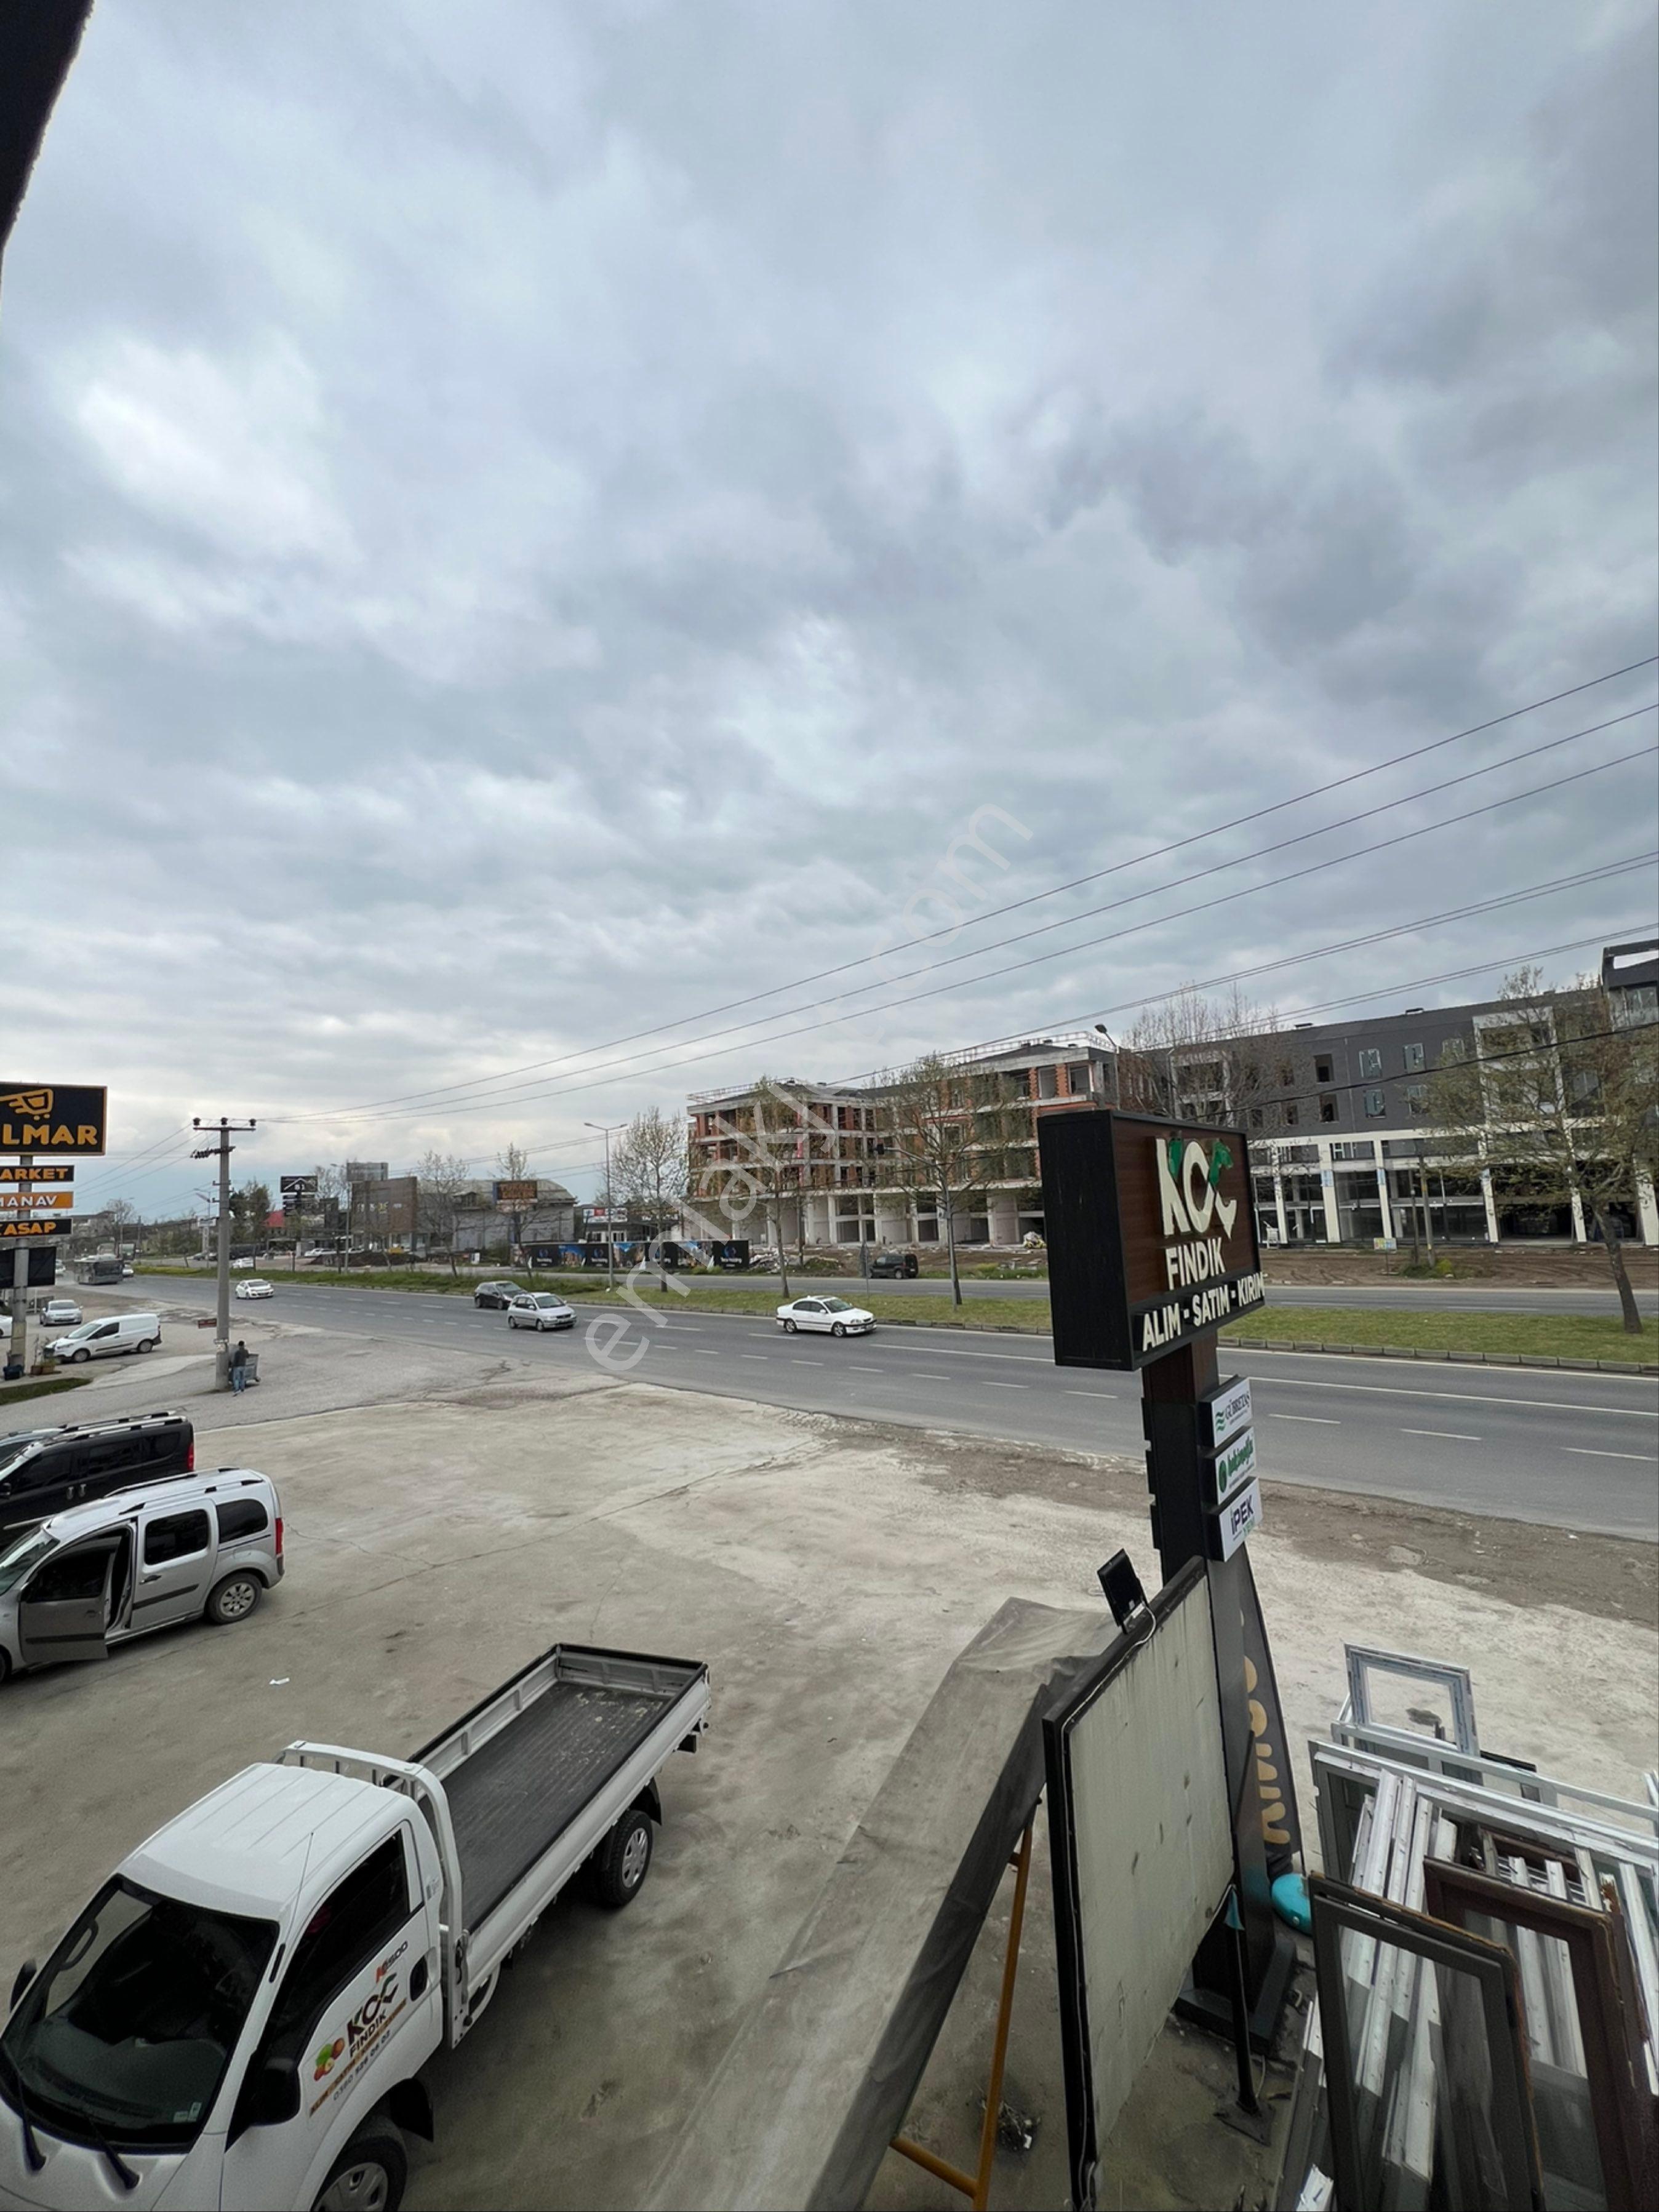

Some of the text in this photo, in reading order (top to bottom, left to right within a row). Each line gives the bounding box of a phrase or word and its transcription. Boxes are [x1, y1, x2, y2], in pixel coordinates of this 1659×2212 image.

[0, 1221, 57, 1236] ASAP
[1165, 1237, 1226, 1290] FINDIK
[1142, 1303, 1182, 1352] ALIM
[1192, 1284, 1230, 1327] SATIM
[349, 2010, 388, 2059] FINDIK
